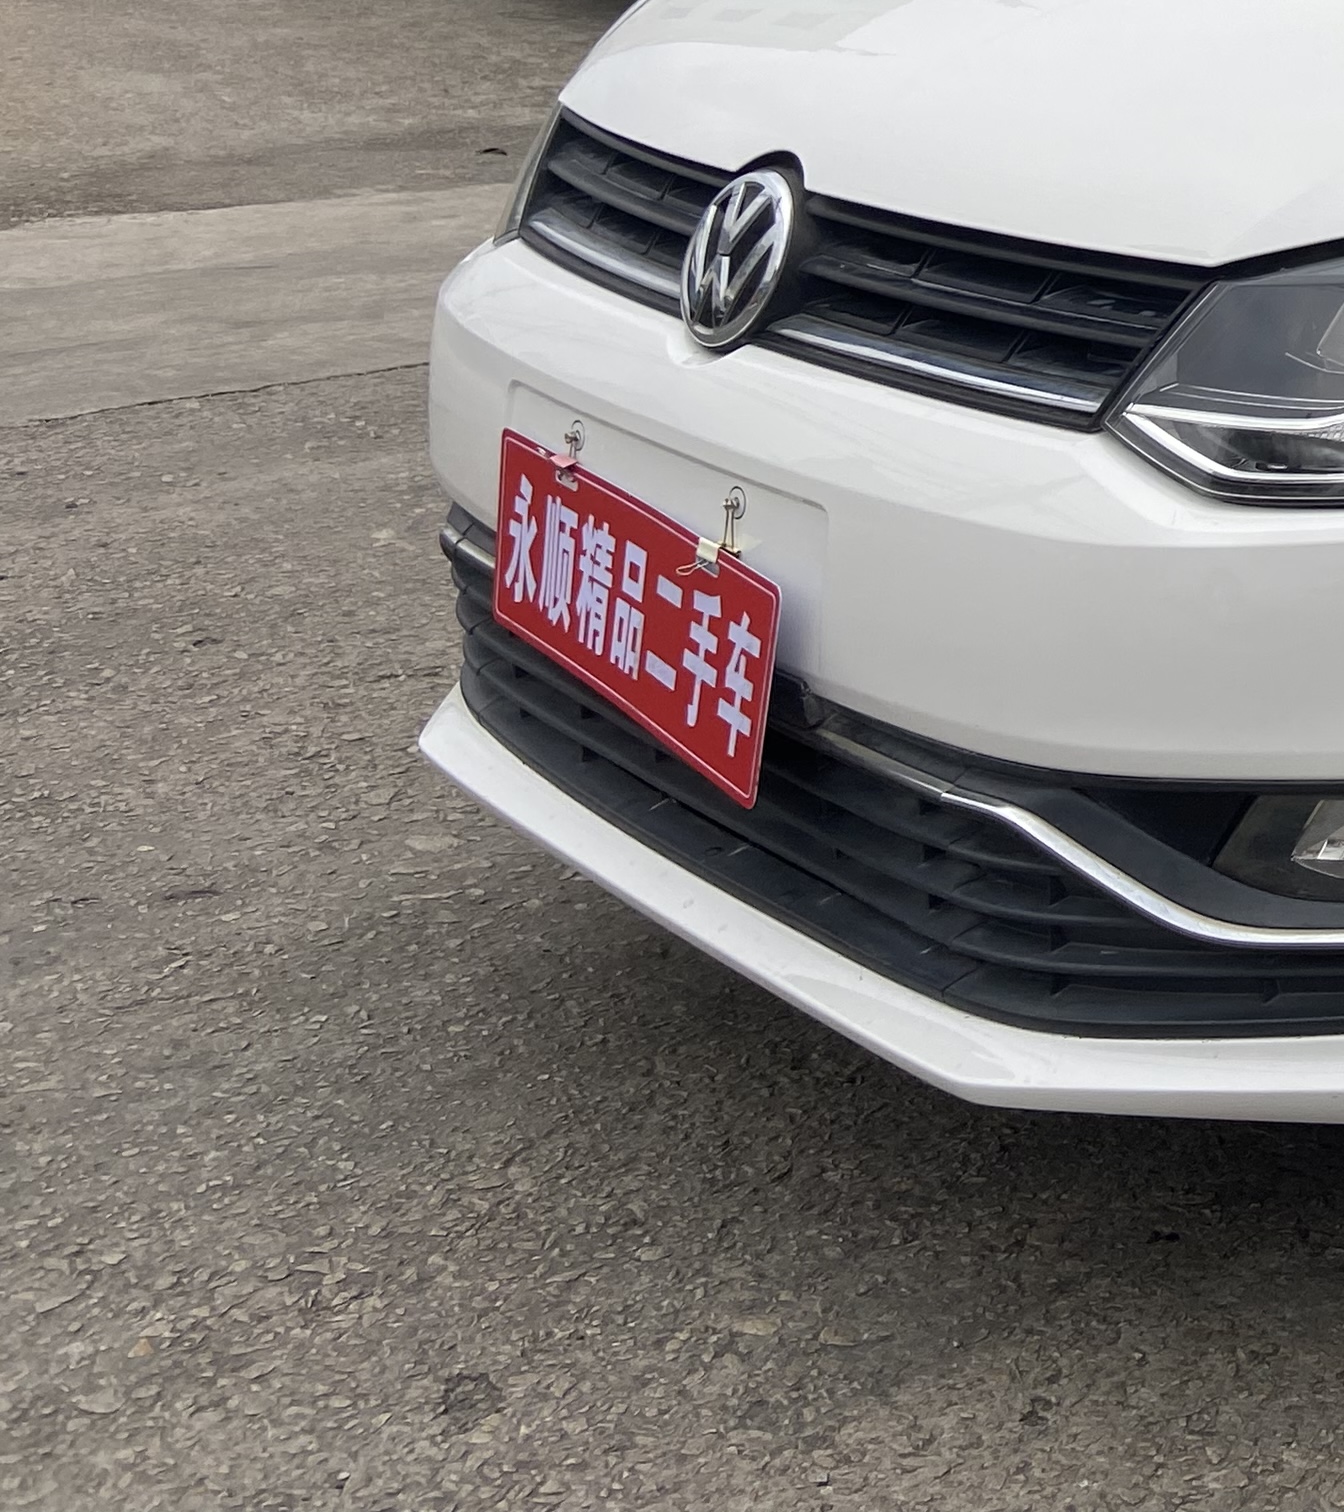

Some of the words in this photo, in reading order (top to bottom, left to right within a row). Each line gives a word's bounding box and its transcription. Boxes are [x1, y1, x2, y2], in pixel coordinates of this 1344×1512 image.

[505, 473, 762, 757] 永顺精品二手车
